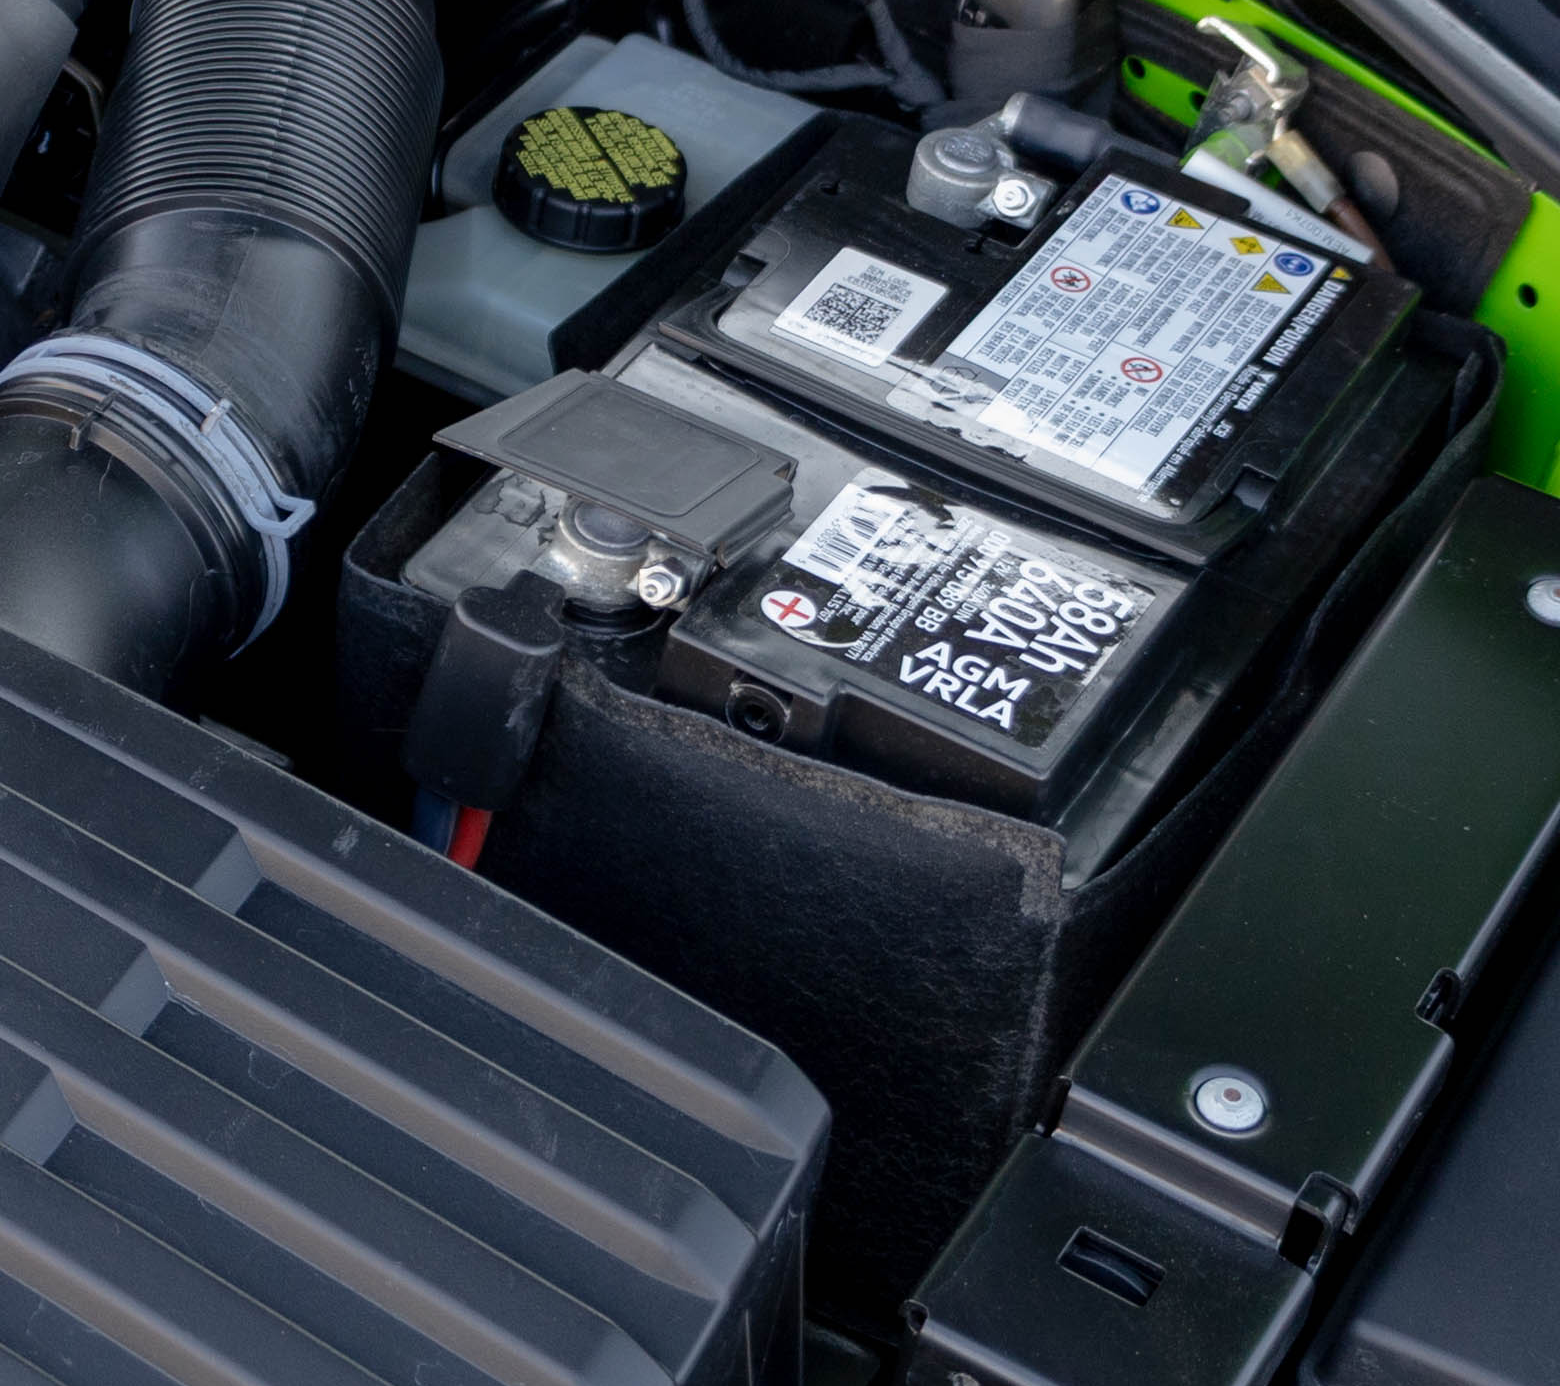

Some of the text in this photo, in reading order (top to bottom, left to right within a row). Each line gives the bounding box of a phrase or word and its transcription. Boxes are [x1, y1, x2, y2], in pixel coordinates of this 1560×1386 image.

[1262, 279, 1344, 366] DANGER/POISON
[1227, 382, 1244, 393] in
[1233, 363, 1260, 385] Made
[1233, 380, 1267, 411] VARTA
[933, 579, 970, 610] 089
[965, 553, 1077, 659] 640A
[913, 604, 948, 633] BB
[952, 600, 978, 623] DIN
[1019, 575, 1133, 676] 58Ah
[915, 640, 1032, 701] AGM
[898, 655, 1014, 730] VRLA
